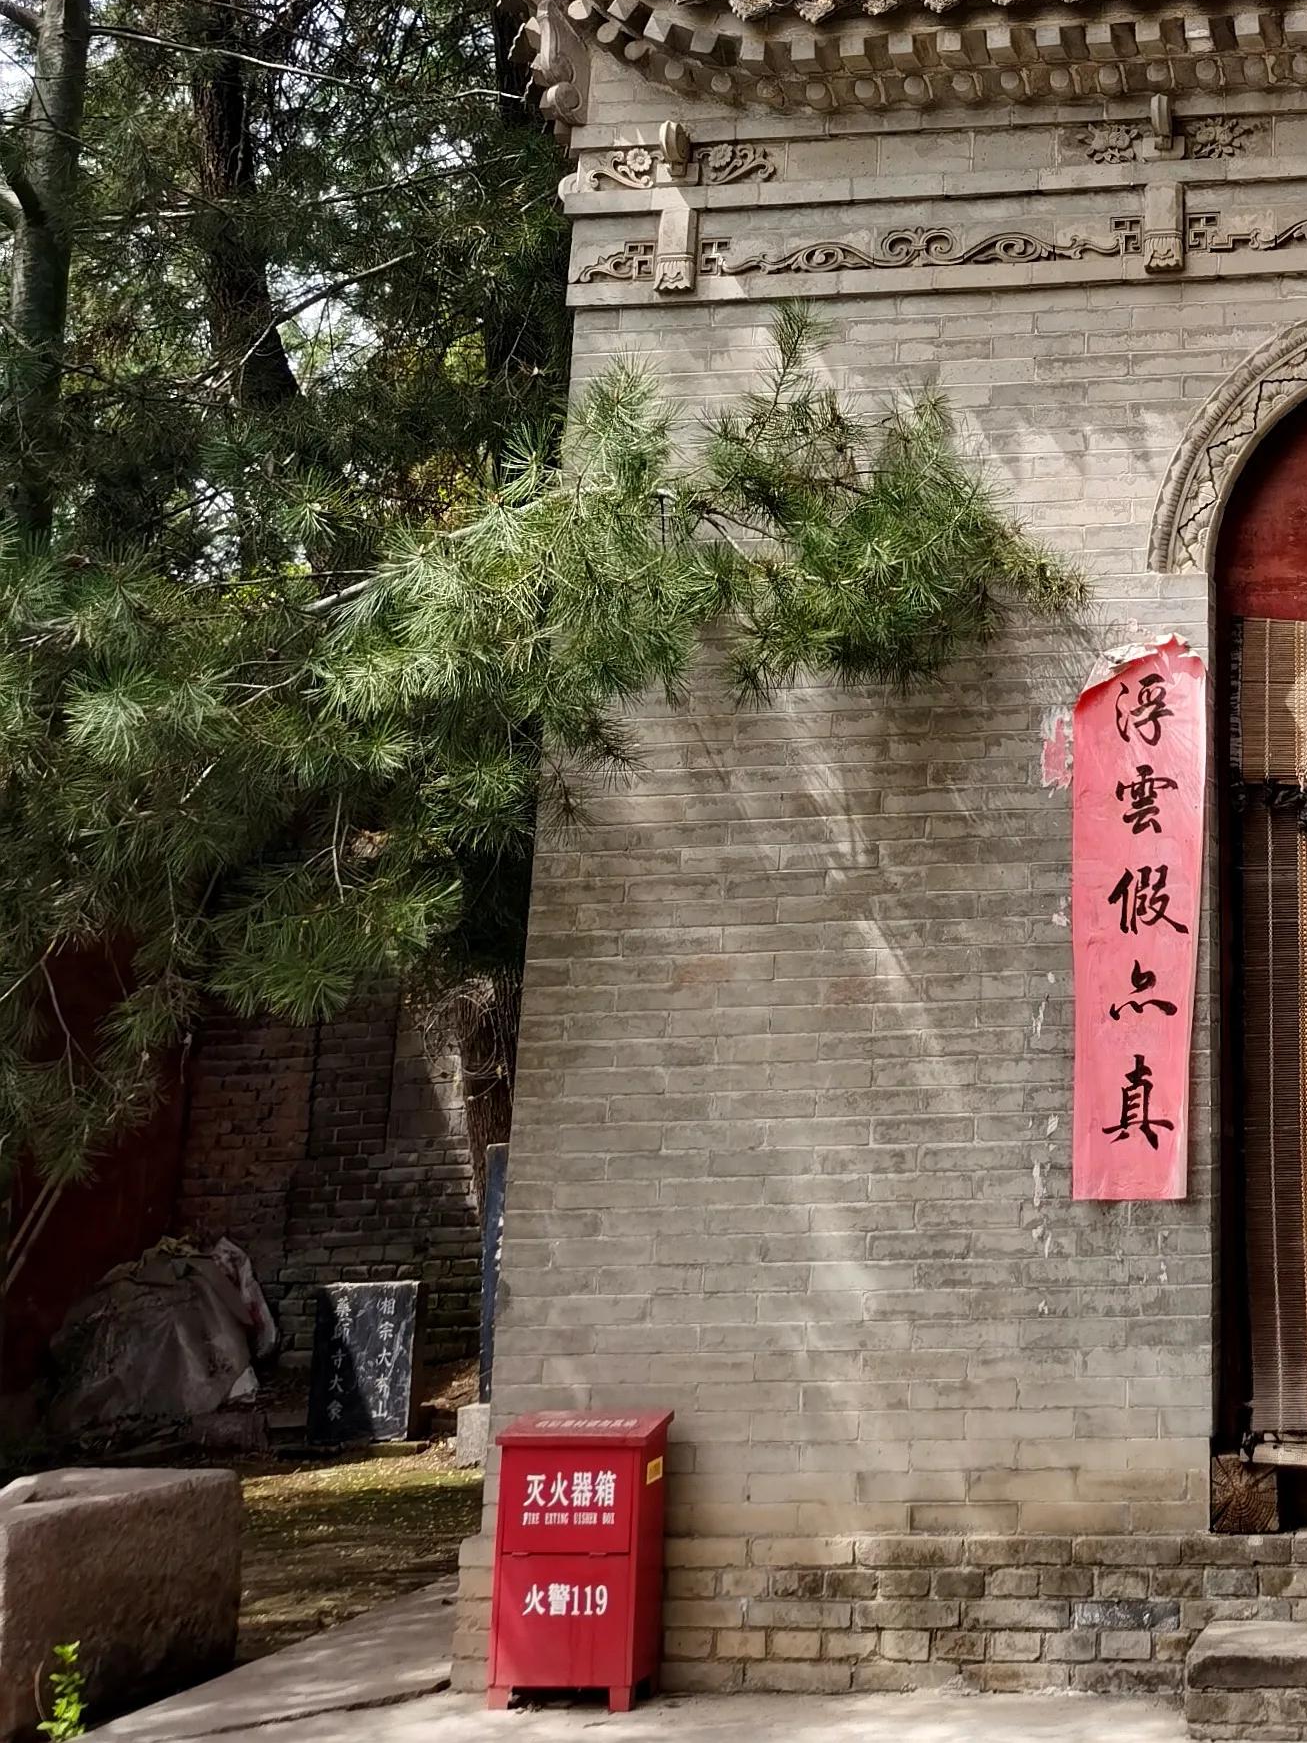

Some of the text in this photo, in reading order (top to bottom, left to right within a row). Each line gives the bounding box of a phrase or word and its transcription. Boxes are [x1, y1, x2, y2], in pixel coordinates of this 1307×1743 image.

[523, 1470, 617, 1508] 灭火器箱
[522, 1582, 608, 1616] 火警119
